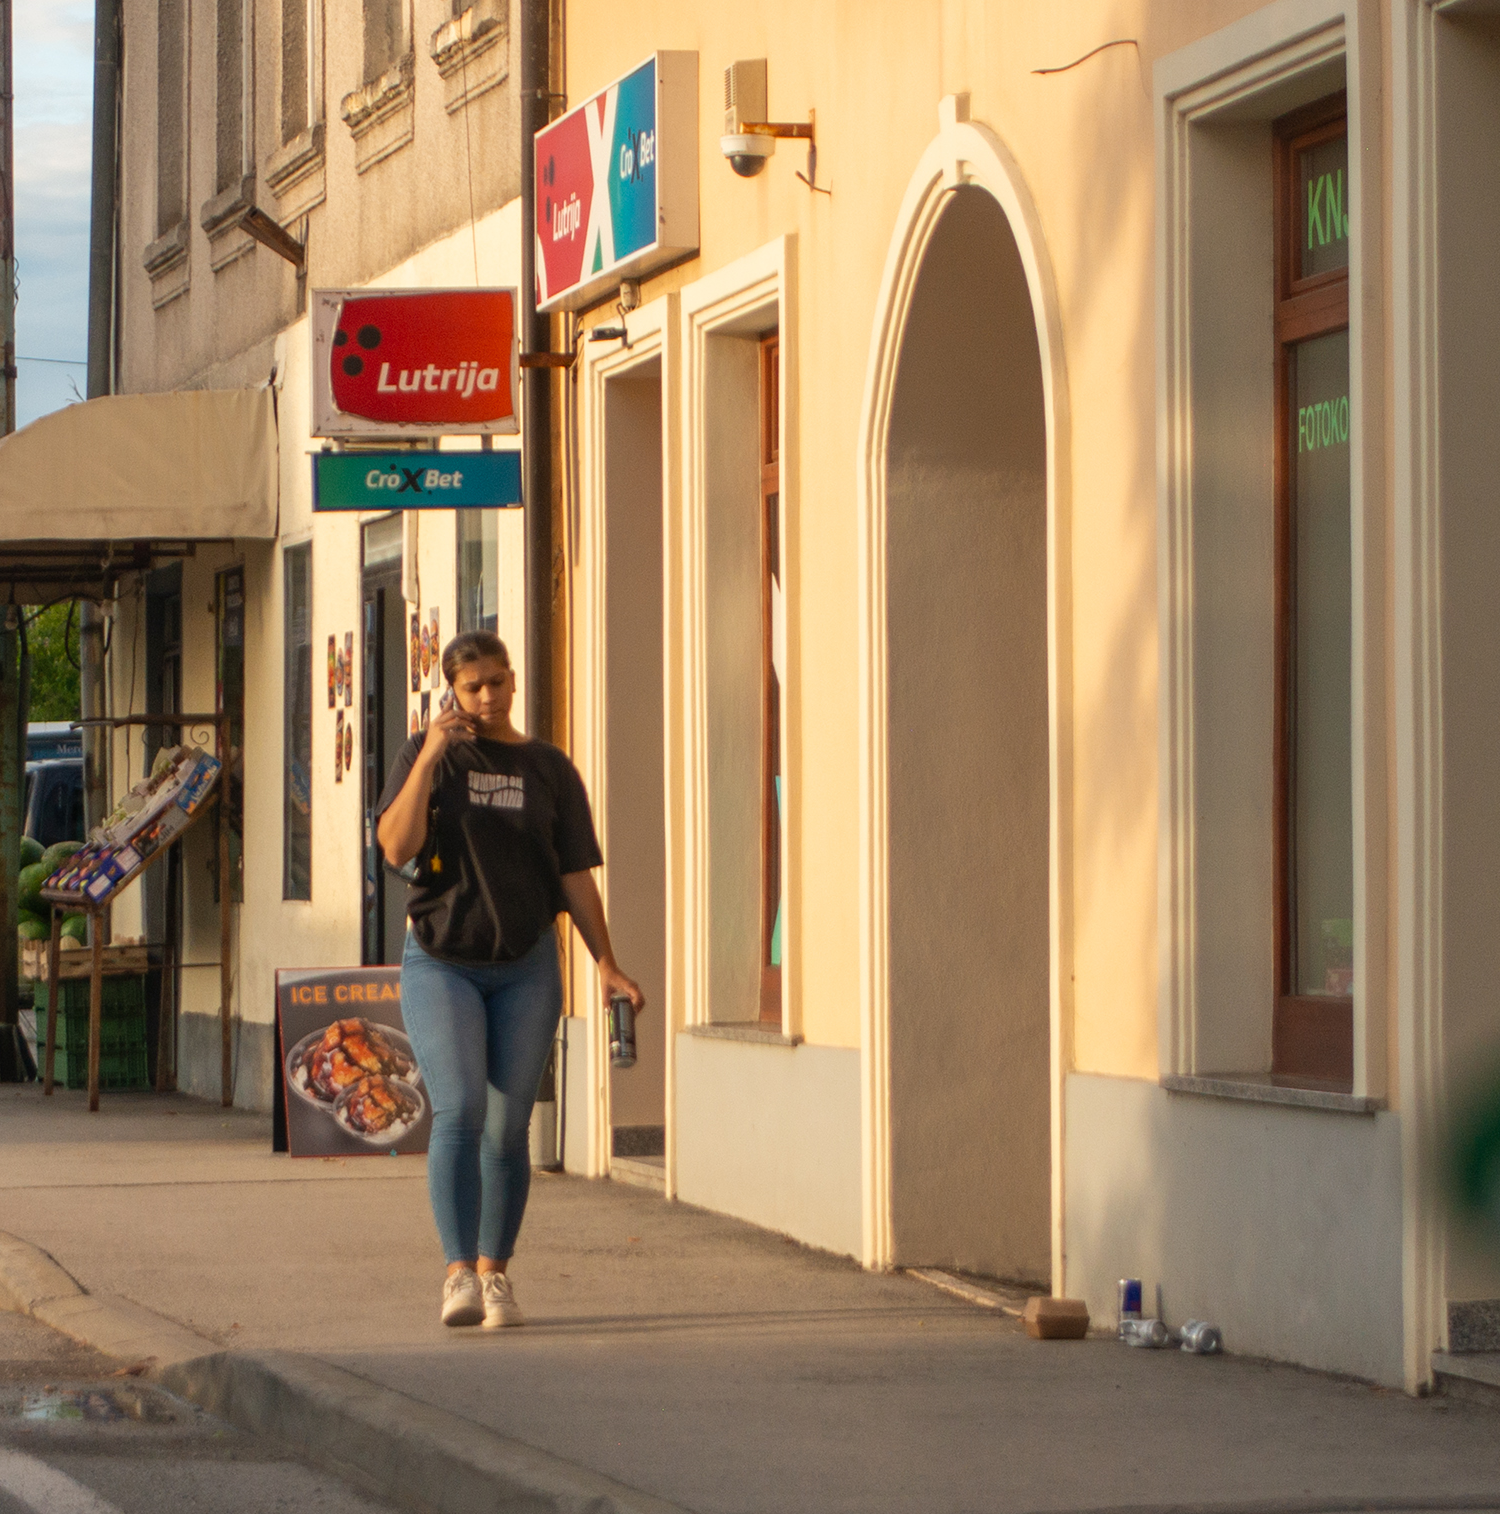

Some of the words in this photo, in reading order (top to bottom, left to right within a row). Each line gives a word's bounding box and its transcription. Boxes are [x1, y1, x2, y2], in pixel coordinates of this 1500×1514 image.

[553, 191, 581, 241] Lutrija
[376, 361, 499, 398] Lutrija
[365, 465, 463, 494] CroXBet
[291, 985, 328, 1004] ICE
[334, 982, 401, 1001] CREA
